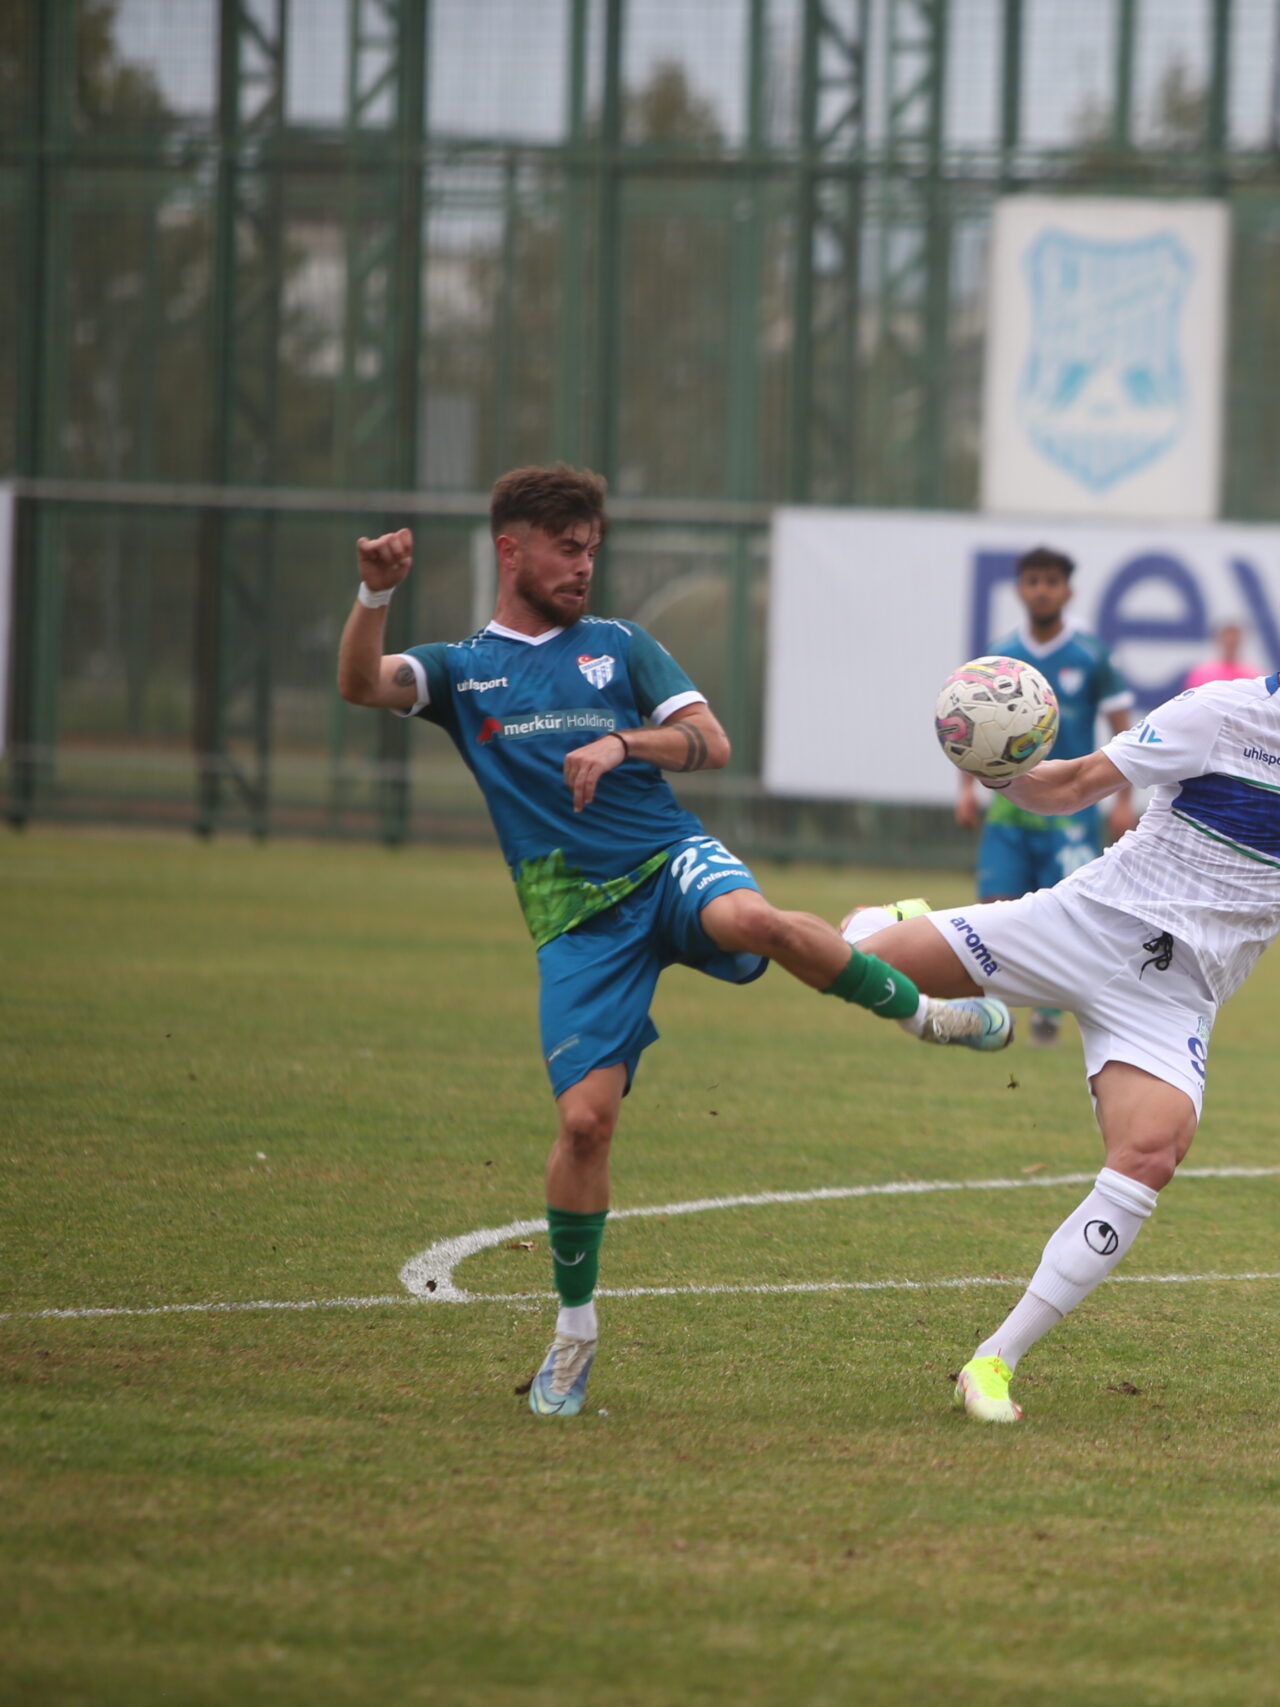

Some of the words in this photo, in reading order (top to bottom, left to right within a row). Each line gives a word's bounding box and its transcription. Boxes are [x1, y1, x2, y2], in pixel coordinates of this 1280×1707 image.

[504, 715, 562, 736] merkür
[567, 713, 615, 732] Holding
[670, 841, 743, 896] 23
[950, 916, 998, 977] aroma
